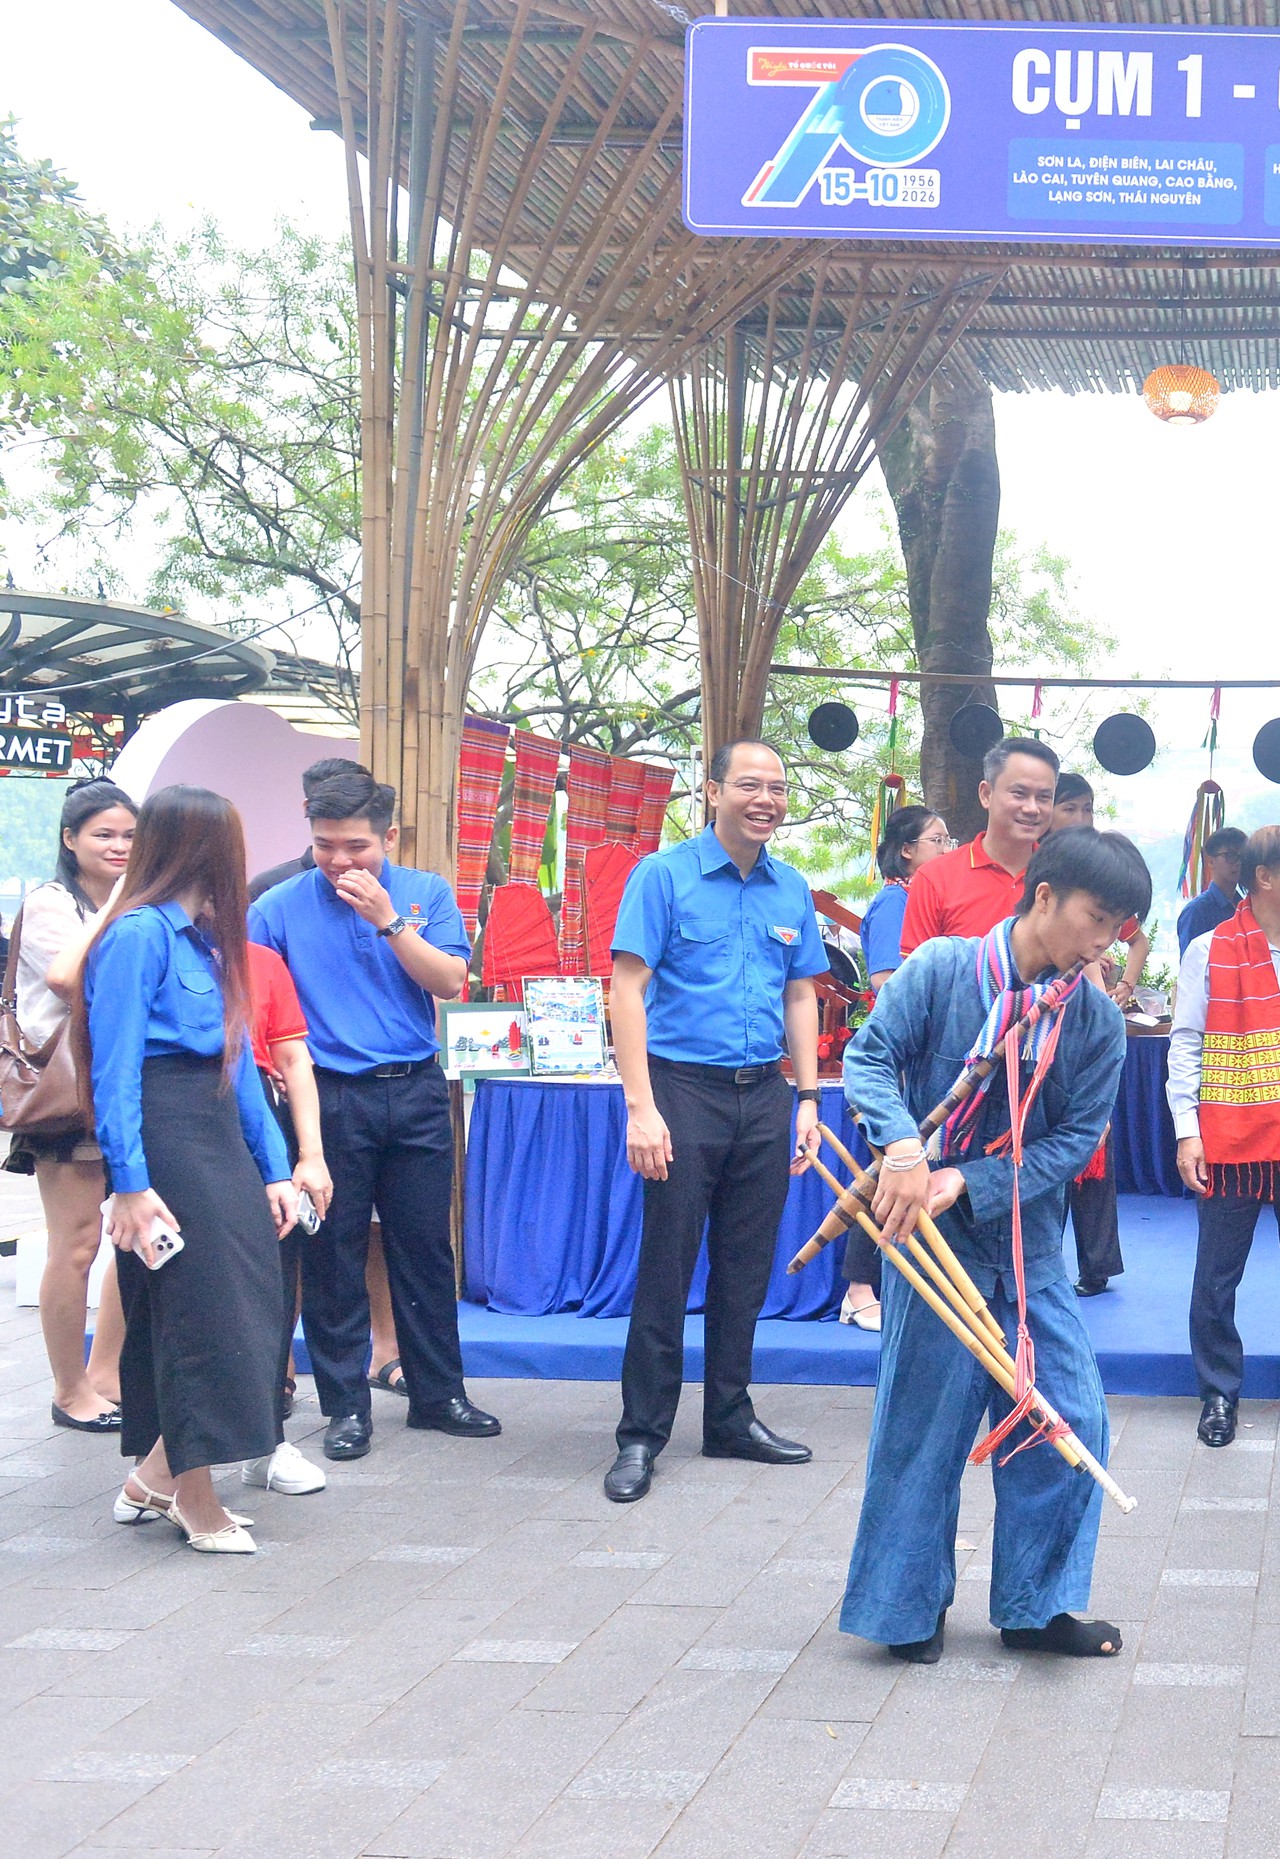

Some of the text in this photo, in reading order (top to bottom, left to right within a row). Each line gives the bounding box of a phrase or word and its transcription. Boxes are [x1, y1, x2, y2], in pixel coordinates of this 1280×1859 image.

[1012, 48, 1153, 130] CỤM
[1177, 53, 1203, 118] 1
[1233, 84, 1256, 98] -
[1037, 155, 1217, 173] SƠN LA, ĐIỆN BIÊN, LAI CHÂU,
[821, 171, 900, 204] 15-10
[903, 174, 935, 188] 1956
[1013, 171, 1238, 191] LÀO CAI, TUYÊN QUANG, CAO BẰNG,
[901, 190, 936, 203] 2026
[1048, 190, 1201, 205] LẠNG SƠN, THÁI NGUYÊN
